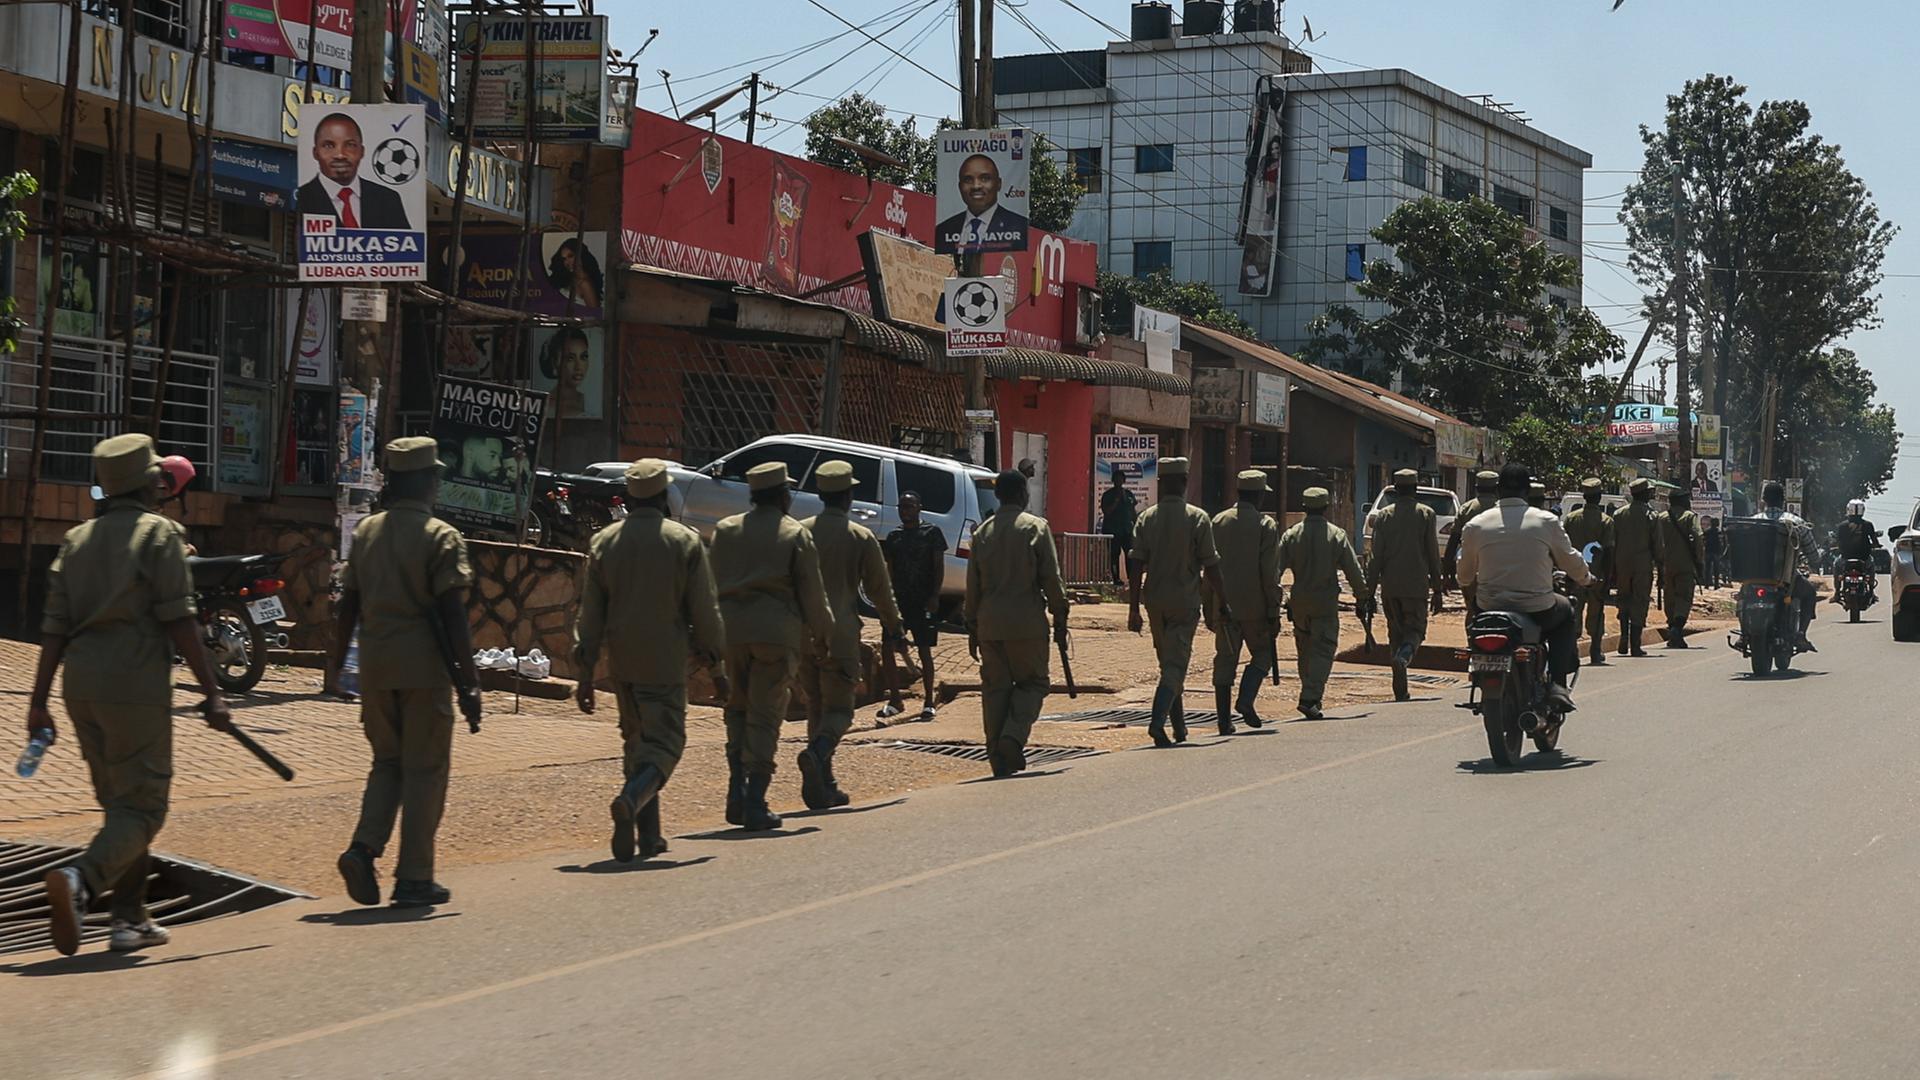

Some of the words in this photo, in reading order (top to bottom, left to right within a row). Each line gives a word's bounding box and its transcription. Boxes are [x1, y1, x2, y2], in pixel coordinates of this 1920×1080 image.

[493, 22, 524, 40] KIN
[532, 22, 592, 40] TRAVEL
[298, 38, 345, 60] KNWLEDGE
[606, 115, 622, 124] TER
[944, 140, 1007, 153] LUKWAGO
[212, 150, 256, 168] Authorised
[257, 160, 280, 174] Agent
[306, 219, 333, 234] MP
[945, 233, 976, 242] LOD
[306, 236, 418, 253] MUKASA
[306, 254, 367, 263] ALOYSIUS
[370, 253, 384, 262] T.G
[305, 265, 366, 278] LUBAGA
[369, 265, 419, 278] SOUTH
[465, 287, 507, 299] Beauty
[951, 334, 1002, 344] MUKASA
[443, 383, 542, 415] MAGNUM
[1628, 424, 1654, 433] 2025
[1097, 437, 1155, 449] MIREMBE
[1119, 463, 1136, 471] MMC
